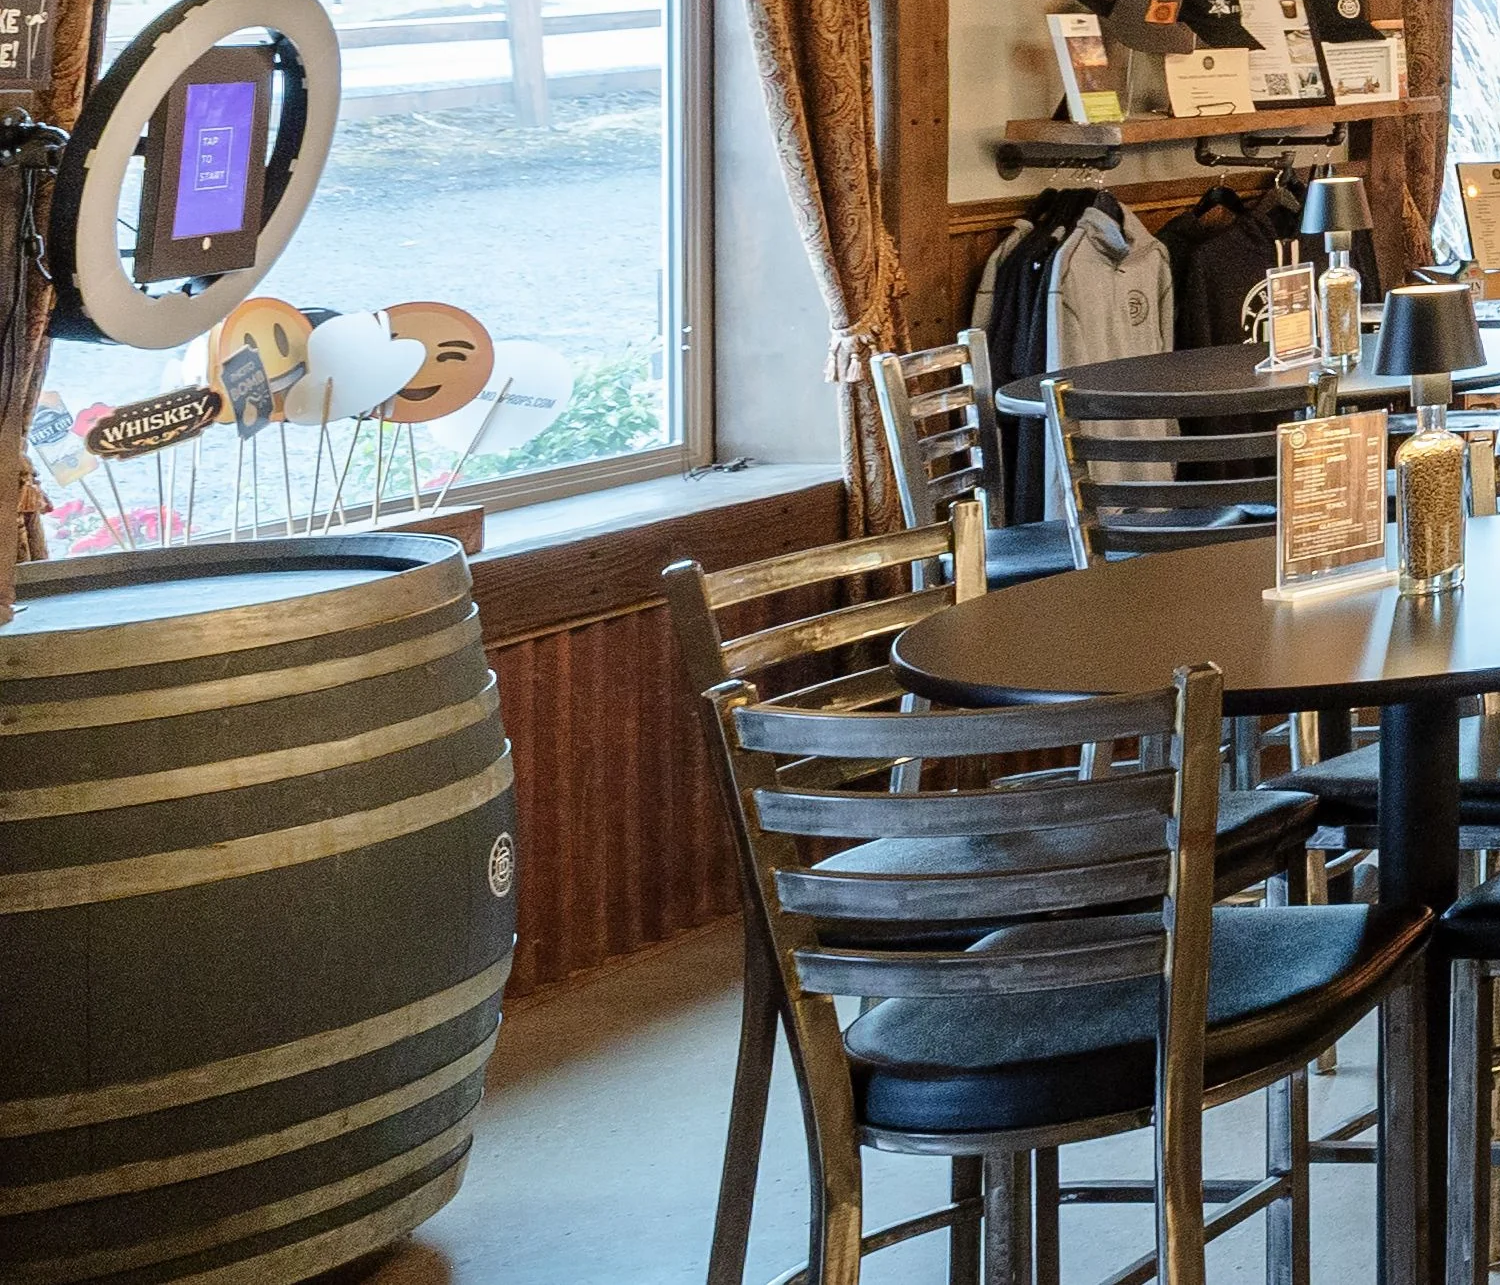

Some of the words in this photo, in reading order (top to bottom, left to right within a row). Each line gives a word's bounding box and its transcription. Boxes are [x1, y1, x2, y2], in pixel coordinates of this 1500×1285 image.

[202, 136, 219, 146] TAP
[201, 155, 213, 164] TO
[199, 170, 225, 182] START
[103, 395, 209, 443] WHISKEY
